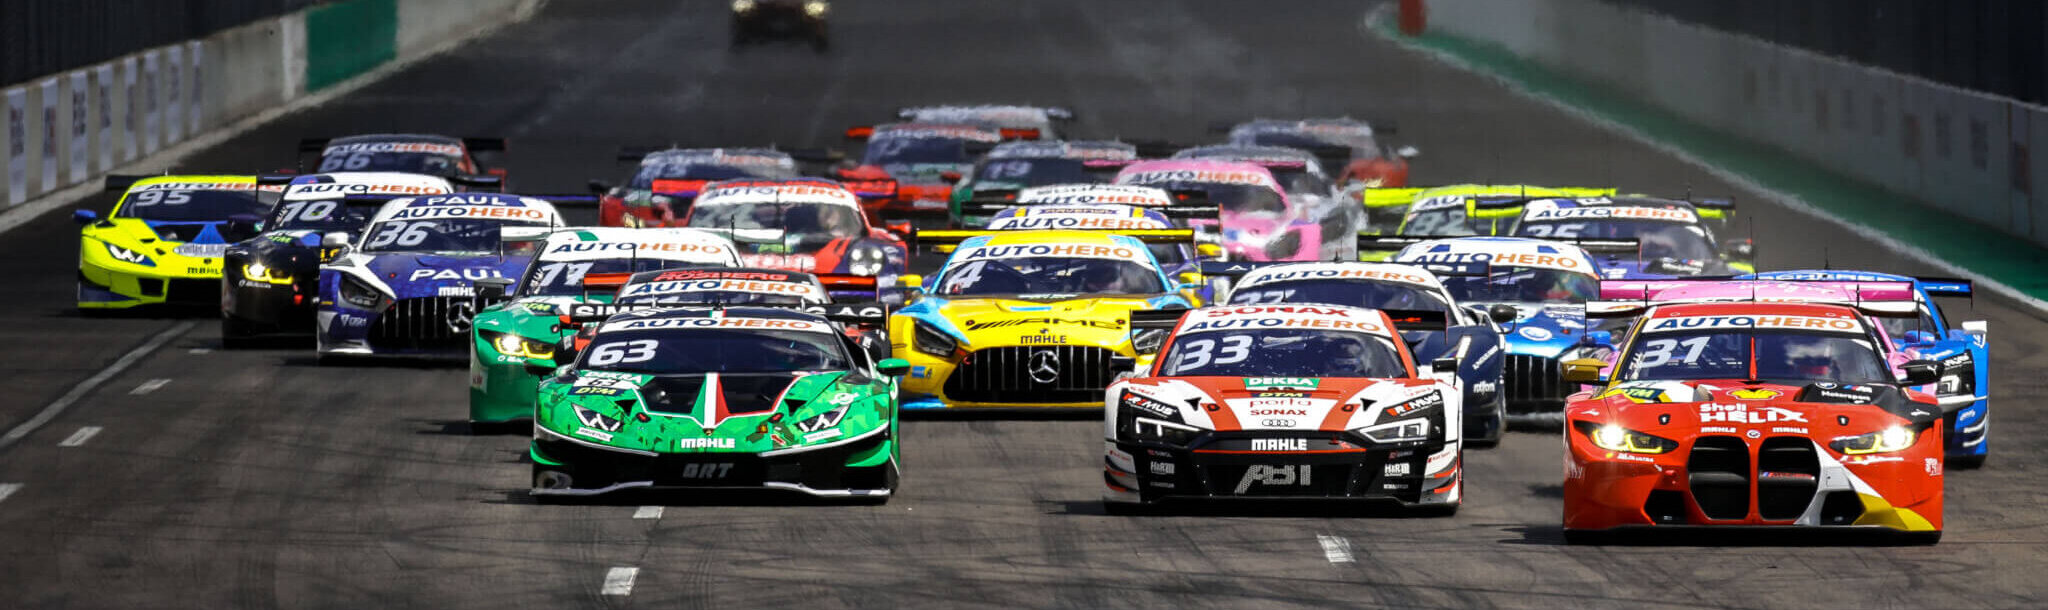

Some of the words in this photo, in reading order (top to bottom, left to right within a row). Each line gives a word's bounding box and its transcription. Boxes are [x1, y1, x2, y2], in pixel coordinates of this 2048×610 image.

[319, 153, 371, 173] 66
[1129, 171, 1262, 184] AUTOHERO
[295, 183, 442, 195] AUTOHERO
[706, 186, 846, 199] AUTOHERO
[135, 190, 193, 207] 95
[427, 196, 507, 206] PAUL
[279, 200, 338, 227] 10
[391, 207, 544, 219] AUTOHERO
[1536, 208, 1689, 219] AUTOHERO
[1002, 218, 1156, 230] AUTOHERO
[367, 221, 438, 248] 36
[552, 242, 722, 254] AUTOHERO
[967, 245, 1134, 260] AUTOHERO
[1415, 253, 1578, 269] AUTOHERO
[187, 267, 224, 275] MAHL
[409, 270, 515, 284] PAUL
[945, 259, 988, 288] 4
[1254, 270, 1426, 283] AUTOHERO
[438, 286, 476, 296] MAHL
[631, 281, 811, 294] AUTOHERO
[1207, 307, 1351, 317] SONAX
[624, 319, 813, 329] AUTOHERO
[1016, 318, 1124, 330] AMG
[1186, 318, 1380, 332] AUTOHERO
[1654, 317, 1854, 330] AUTOHERO
[1020, 335, 1067, 344] MAHLE
[588, 340, 659, 367] 63
[1177, 335, 1253, 372] 33
[1638, 337, 1710, 369] 31
[1249, 377, 1314, 386] DEKRA
[1821, 390, 1871, 401] Motorsport
[1250, 398, 1312, 408] porta
[1700, 403, 1748, 413] Shell
[1700, 408, 1809, 424] HELIX
[681, 438, 736, 449] MAHLE
[1251, 438, 1307, 451] MAHLE
